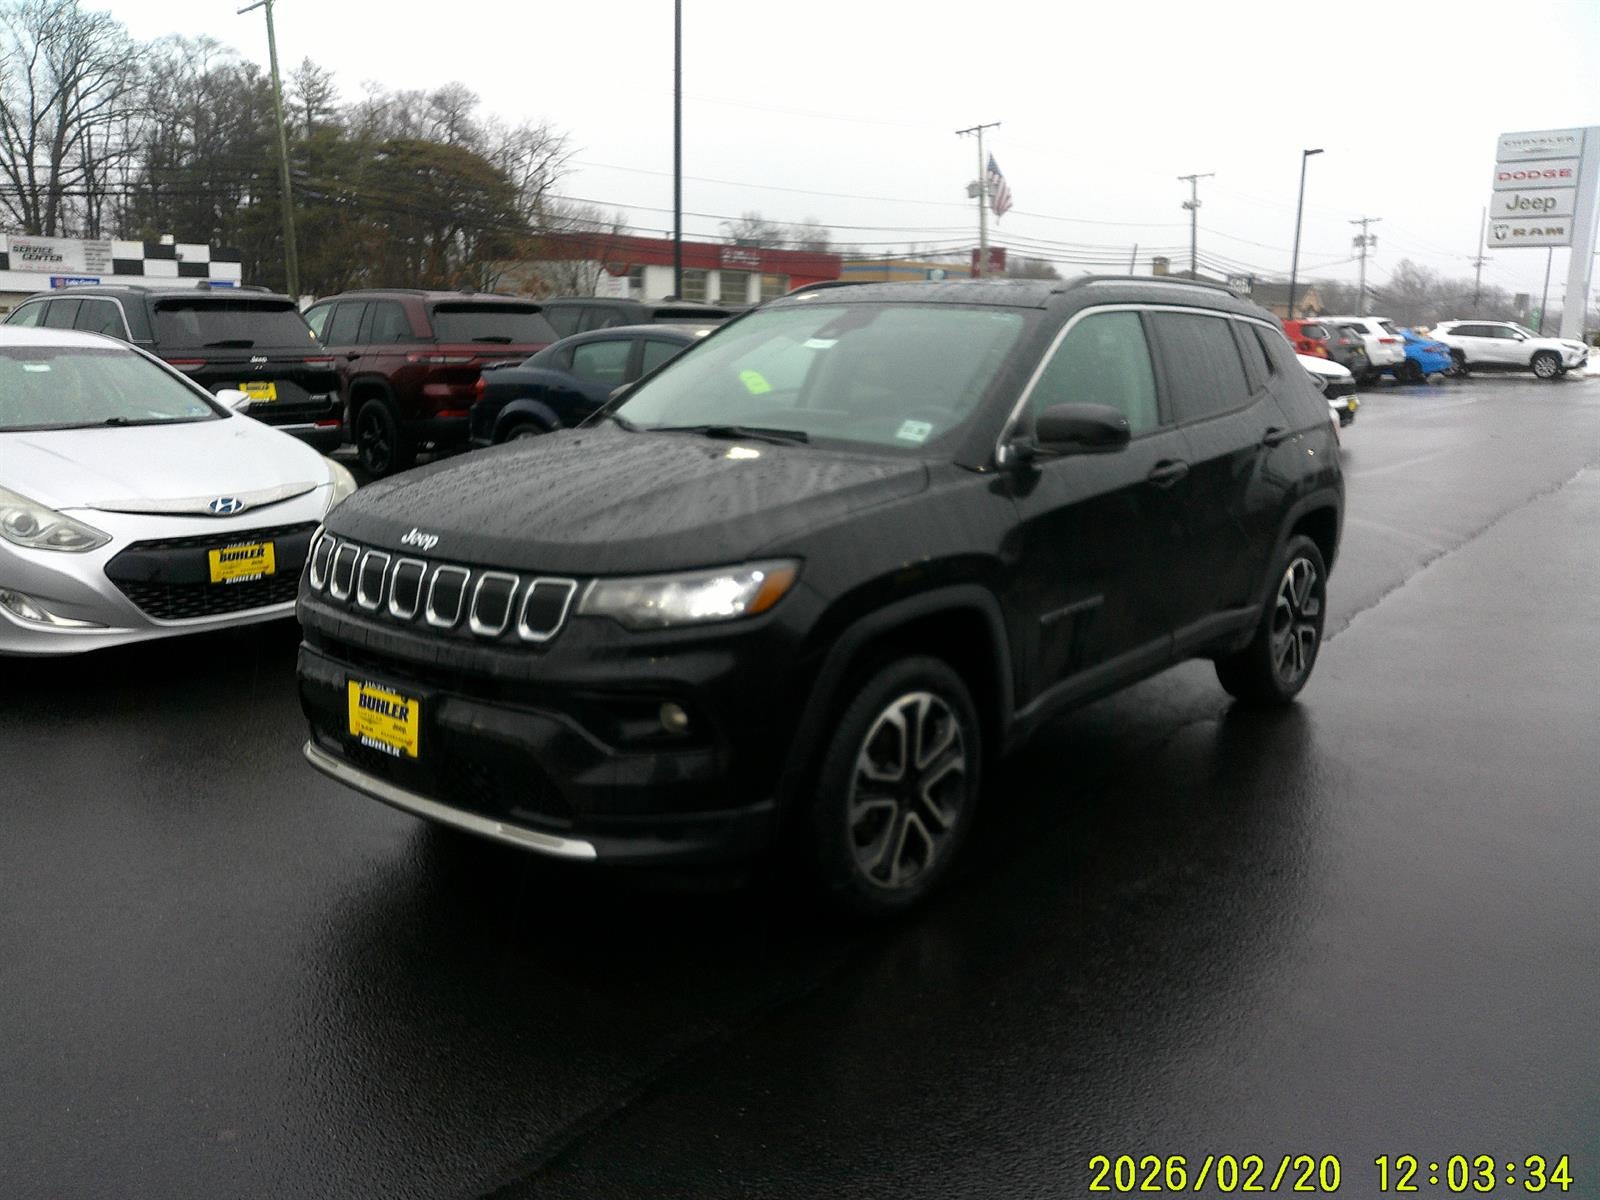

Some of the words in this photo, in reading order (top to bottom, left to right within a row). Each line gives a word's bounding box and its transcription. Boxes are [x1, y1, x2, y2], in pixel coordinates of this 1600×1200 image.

[1498, 168, 1573, 181] DODGE
[1506, 194, 1557, 212] Jeep
[1512, 227, 1564, 237] RAM
[12, 245, 54, 254] SERVICE
[22, 253, 63, 262] CENTER
[401, 528, 439, 551] Jeep
[219, 548, 264, 562] BUHLER
[225, 573, 262, 584] BUHLER
[359, 693, 409, 723] BUHLER
[361, 735, 400, 758] BUHLER
